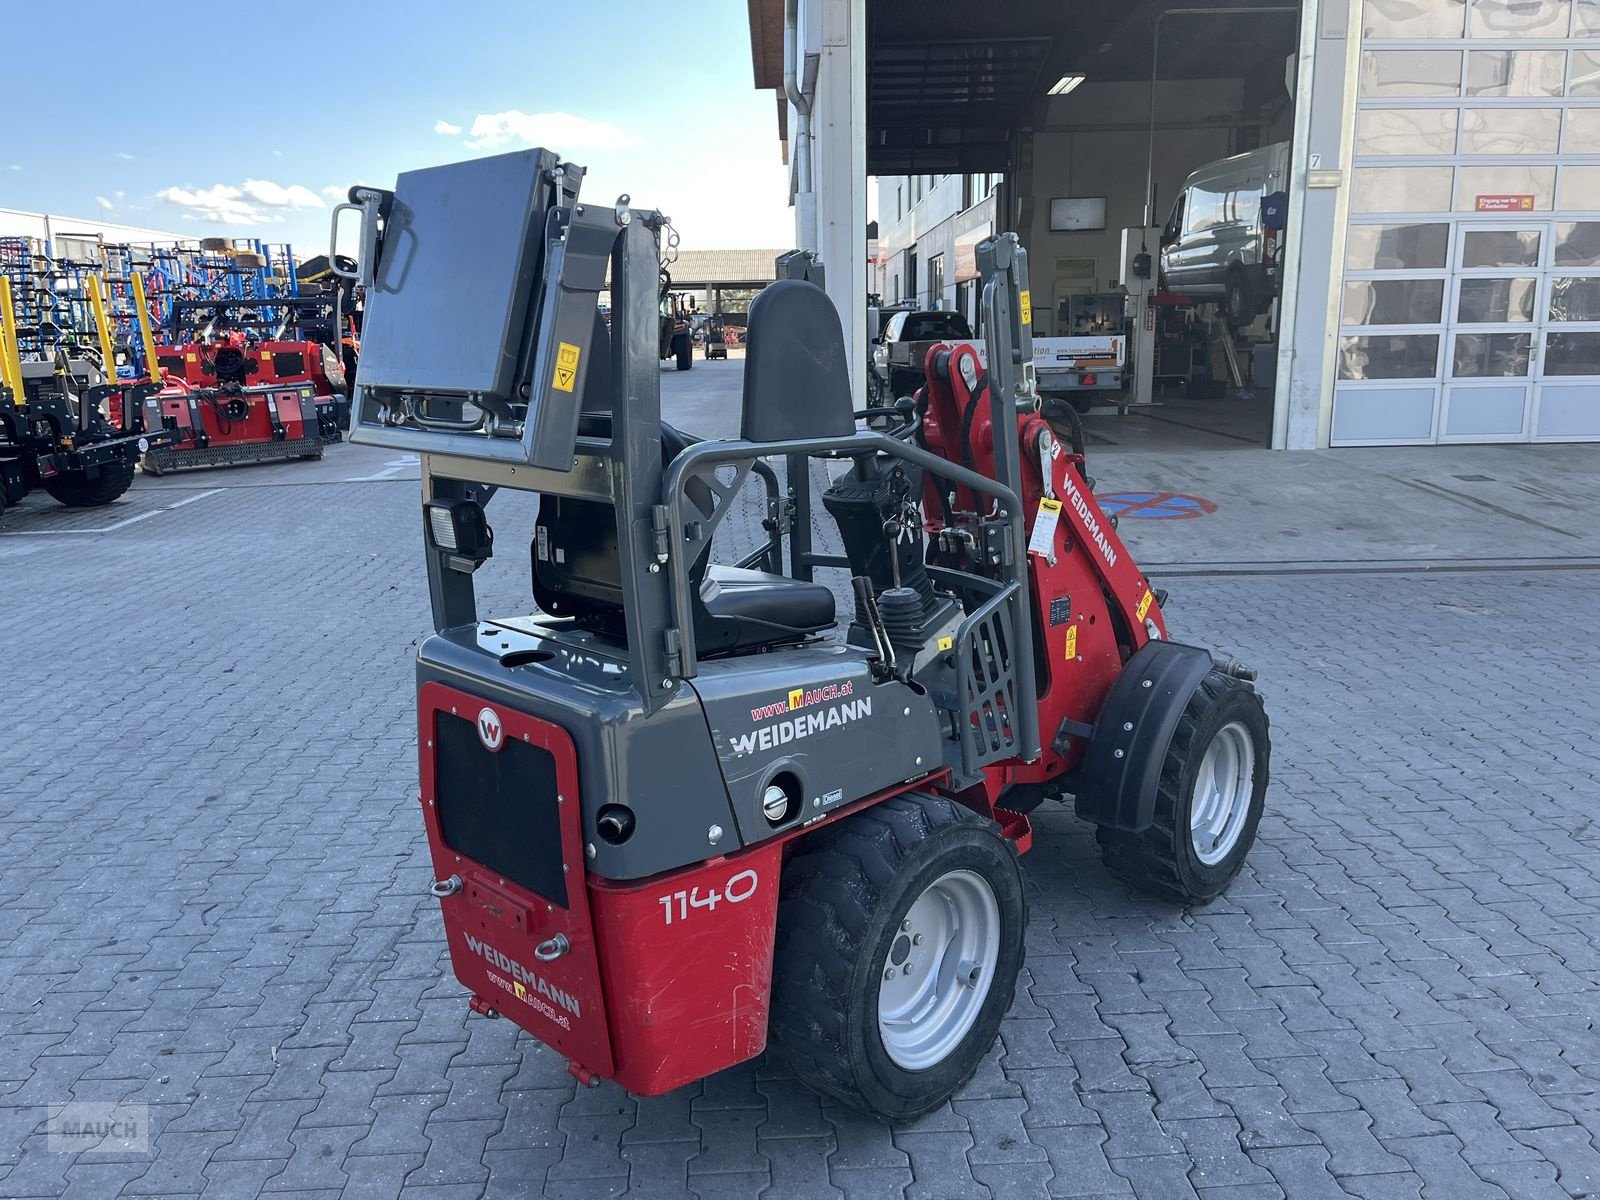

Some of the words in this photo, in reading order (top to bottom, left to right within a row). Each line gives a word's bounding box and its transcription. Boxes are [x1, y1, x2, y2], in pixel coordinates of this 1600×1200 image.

[1311, 155, 1320, 168] 7
[1063, 472, 1117, 568] WEIDEMANN
[729, 696, 872, 757] WEIDEMANN
[750, 680, 853, 722] www.MAUCH.at
[480, 719, 500, 742] W
[658, 869, 758, 925] 1140
[463, 931, 581, 1018] WEIDEMANN
